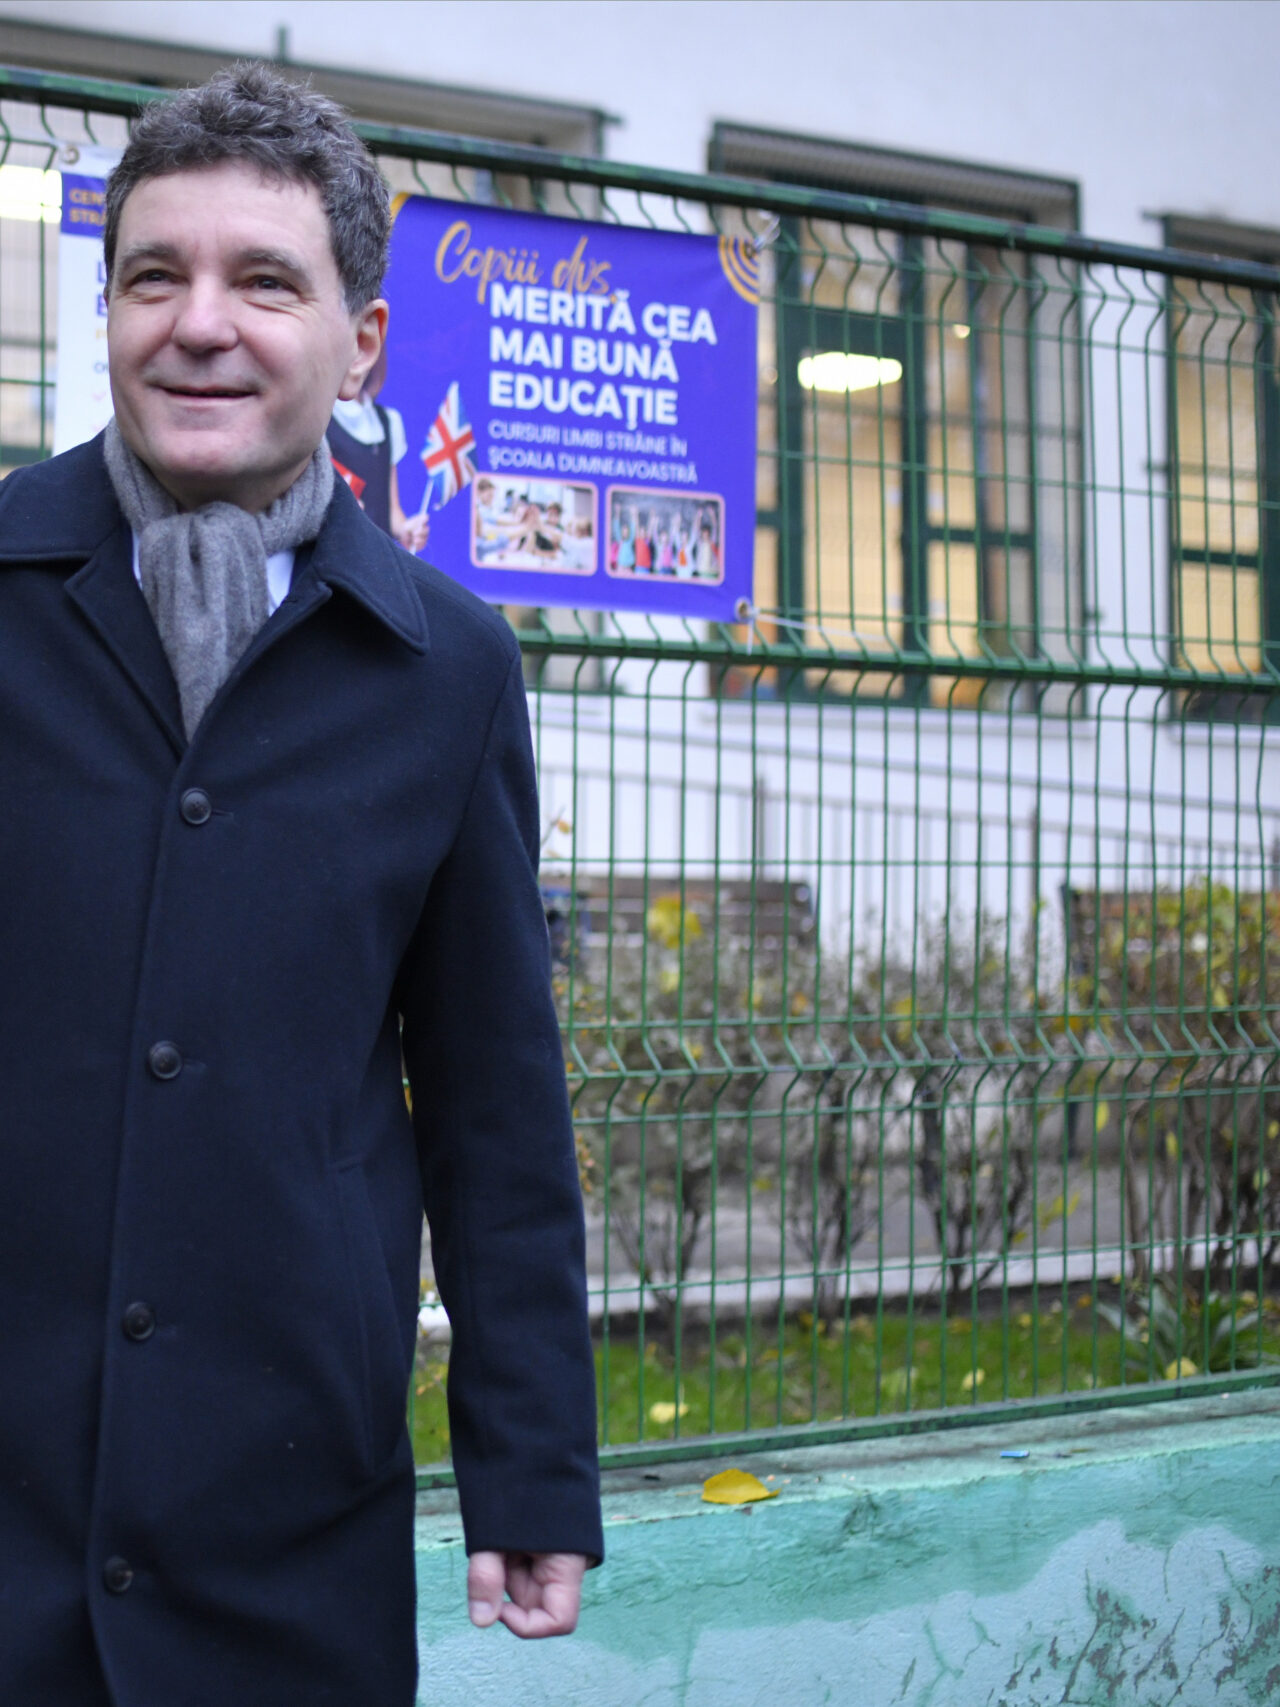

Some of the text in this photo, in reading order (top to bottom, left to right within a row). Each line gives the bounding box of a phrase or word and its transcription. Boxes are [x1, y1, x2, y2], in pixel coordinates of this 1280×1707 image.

[435, 220, 543, 304] Copiii
[490, 282, 718, 345] MERITĂ CEA
[490, 326, 679, 383] MAI BUNĂ
[488, 419, 561, 445] CURSURI
[562, 425, 604, 449] LIMBI
[670, 433, 688, 457] ÎN
[558, 451, 699, 484] DUMNEAVOASTRĂ
